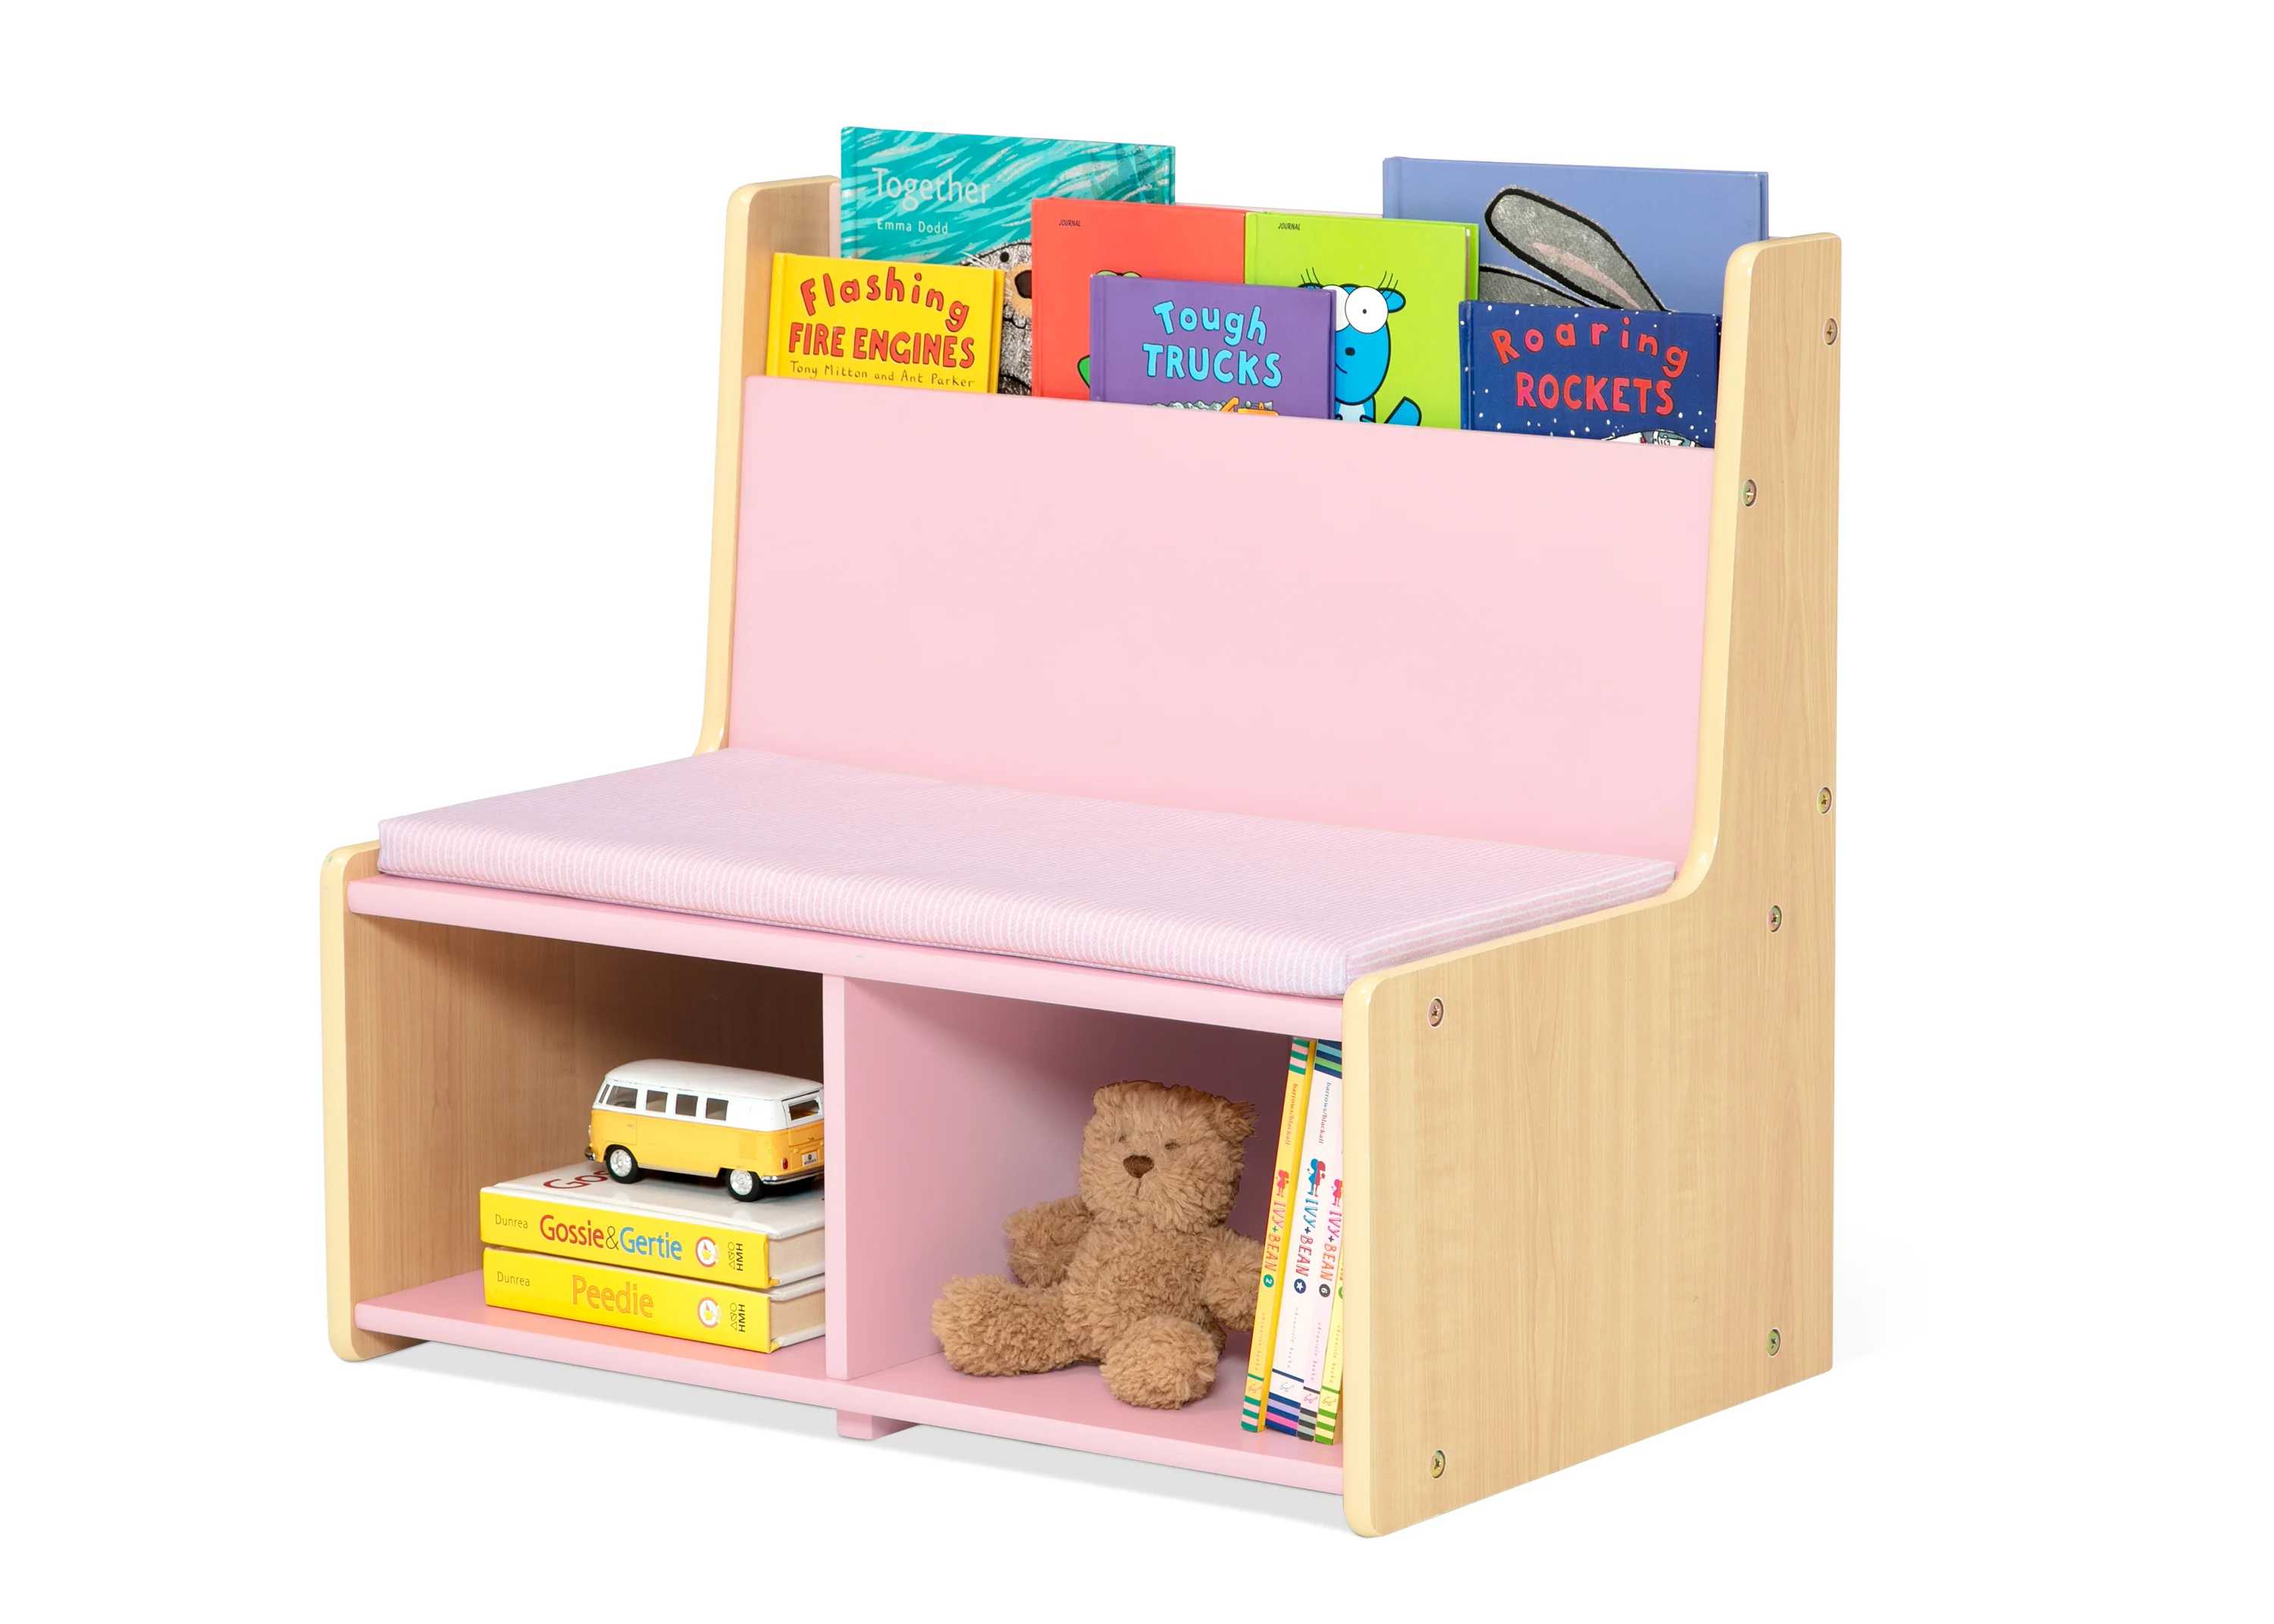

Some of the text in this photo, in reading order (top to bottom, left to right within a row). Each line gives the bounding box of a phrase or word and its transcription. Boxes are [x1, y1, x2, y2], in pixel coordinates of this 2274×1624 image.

[872, 167, 991, 211] Together
[877, 218, 948, 235] Emma Dodd
[1058, 218, 1081, 227] JOURNAL
[1277, 222, 1301, 231] JOURNAL
[800, 266, 969, 333] Flashing
[1152, 300, 1267, 346] Tough
[788, 322, 975, 369] FIRE ENGINES
[1142, 343, 1283, 388] TRUCKS
[1491, 316, 1689, 379] Roaring
[790, 360, 976, 387] Tony Mitton and Ant Parker
[1516, 371, 1674, 415] ROCKETS
[495, 1214, 528, 1229] Dunrea
[496, 1271, 654, 1318] Dunrea Peedie
